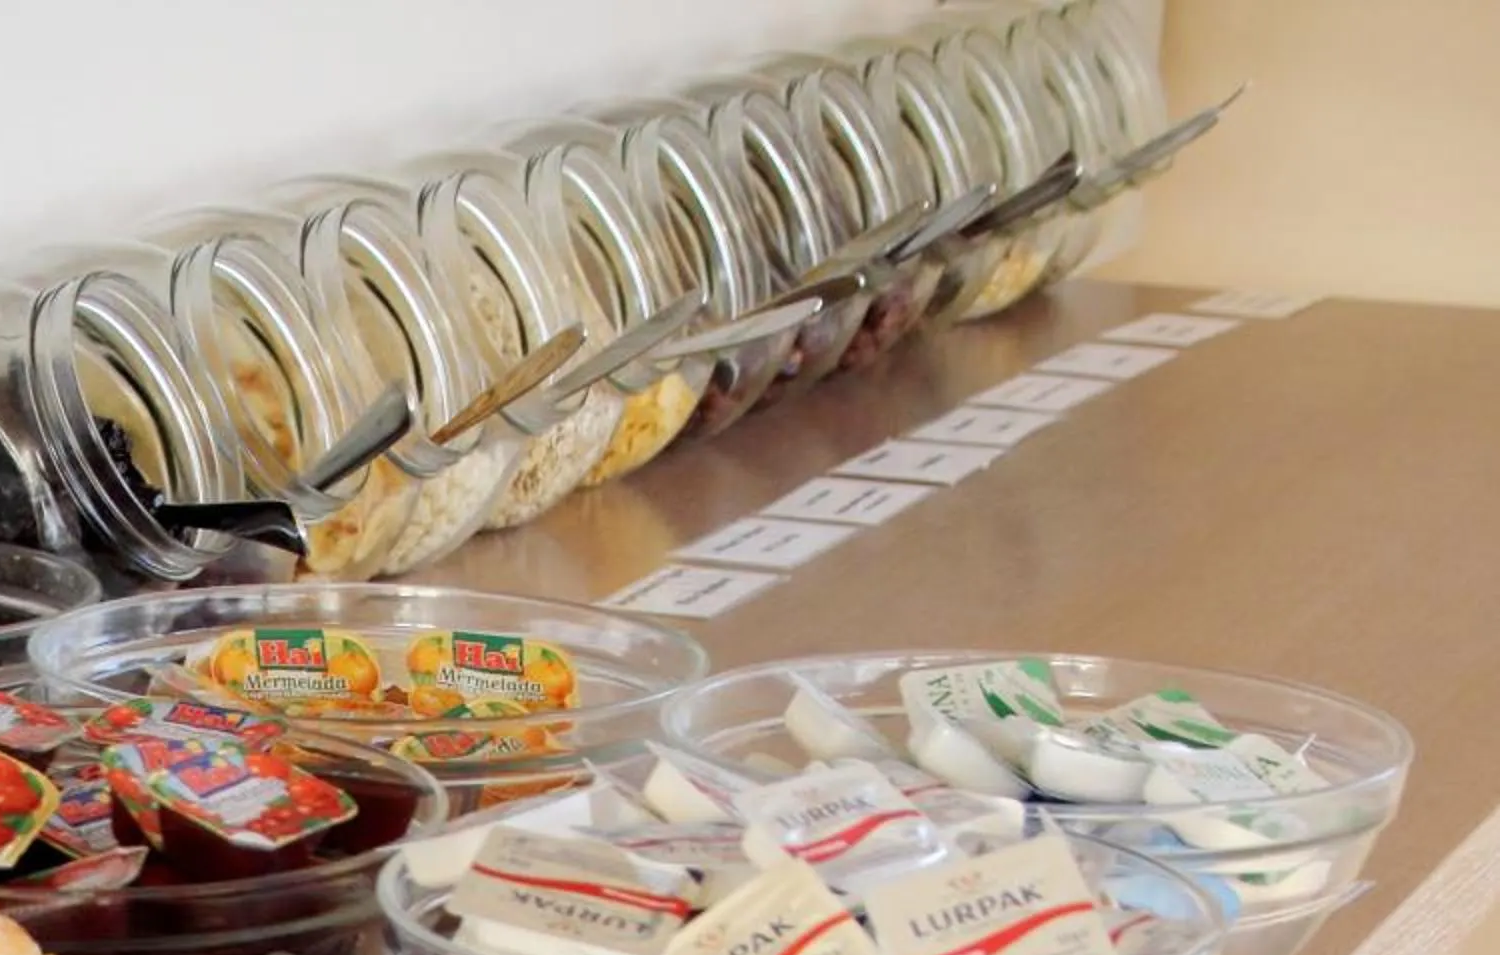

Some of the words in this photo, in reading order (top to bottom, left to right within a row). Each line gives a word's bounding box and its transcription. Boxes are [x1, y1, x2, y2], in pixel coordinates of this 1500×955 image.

[258, 638, 324, 667] Hai
[455, 638, 522, 672] Hai
[245, 673, 347, 691] Mermelada
[438, 667, 543, 693] Mermelada
[775, 795, 872, 831] LURPAK
[908, 883, 1044, 938] LURPAK
